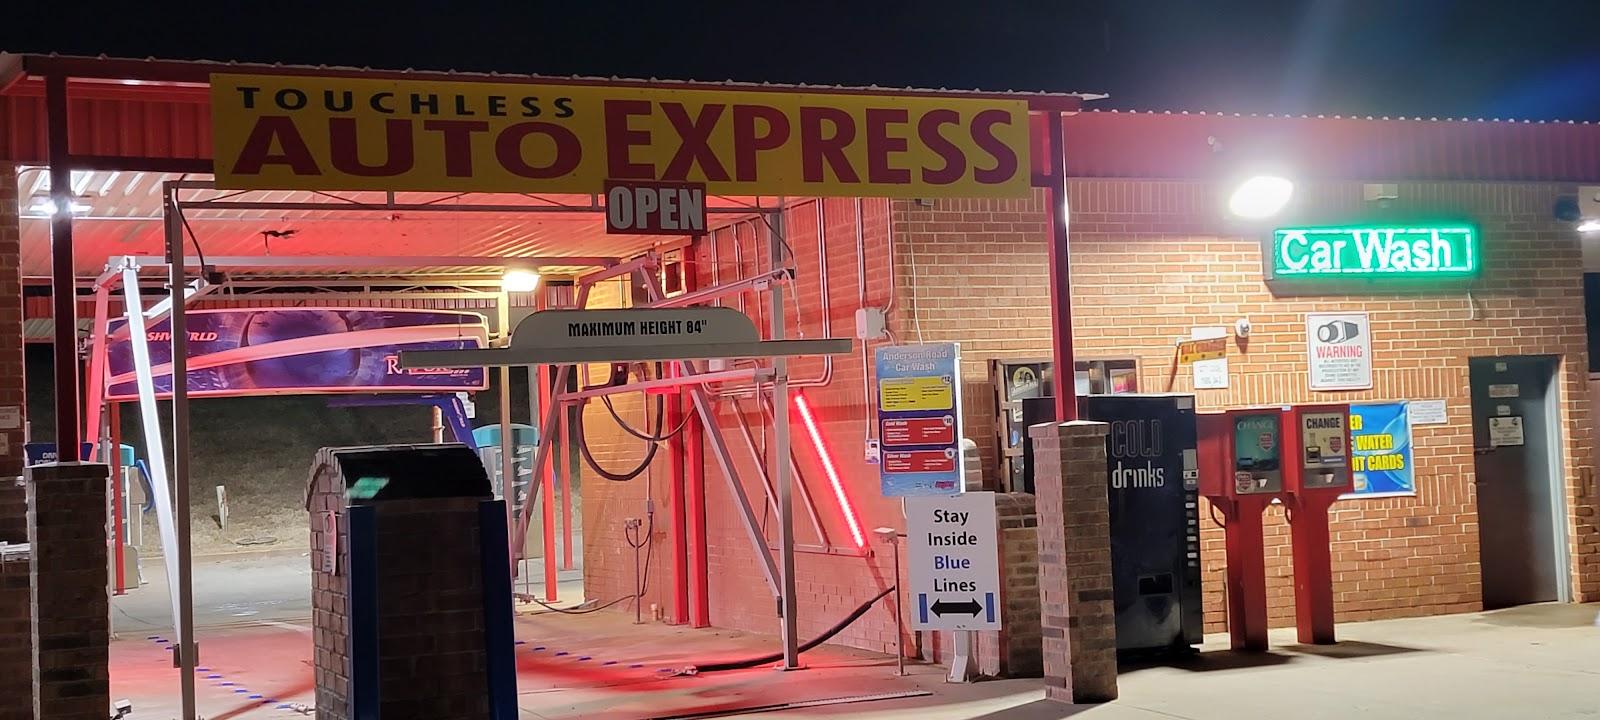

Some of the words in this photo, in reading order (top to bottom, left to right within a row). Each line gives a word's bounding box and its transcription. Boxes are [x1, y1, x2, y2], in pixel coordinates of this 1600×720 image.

[236, 86, 575, 118] TOUCHLESS
[231, 115, 582, 179] AUTO
[603, 99, 1018, 186] EXPRESS
[609, 186, 703, 231] OPEN
[1280, 230, 1347, 271] Car
[1351, 229, 1452, 270] Wash
[568, 321, 635, 337] MAXIMUM
[640, 320, 682, 335] HEIGHT
[686, 319, 707, 334] 84"
[882, 350, 923, 361] Anderson
[925, 349, 948, 359] Road
[1316, 345, 1363, 359] WARNING
[895, 364, 910, 372] Car
[912, 362, 935, 372] Wash
[1306, 417, 1340, 429] CHANGE
[1111, 419, 1162, 458] COLD
[1356, 434, 1393, 451] WATER
[1367, 453, 1405, 471] CARDS
[1112, 460, 1165, 488] drinks
[934, 509, 969, 526] Stay
[928, 531, 978, 546] Inside
[934, 555, 971, 570] Blue
[934, 578, 977, 592] Lines
